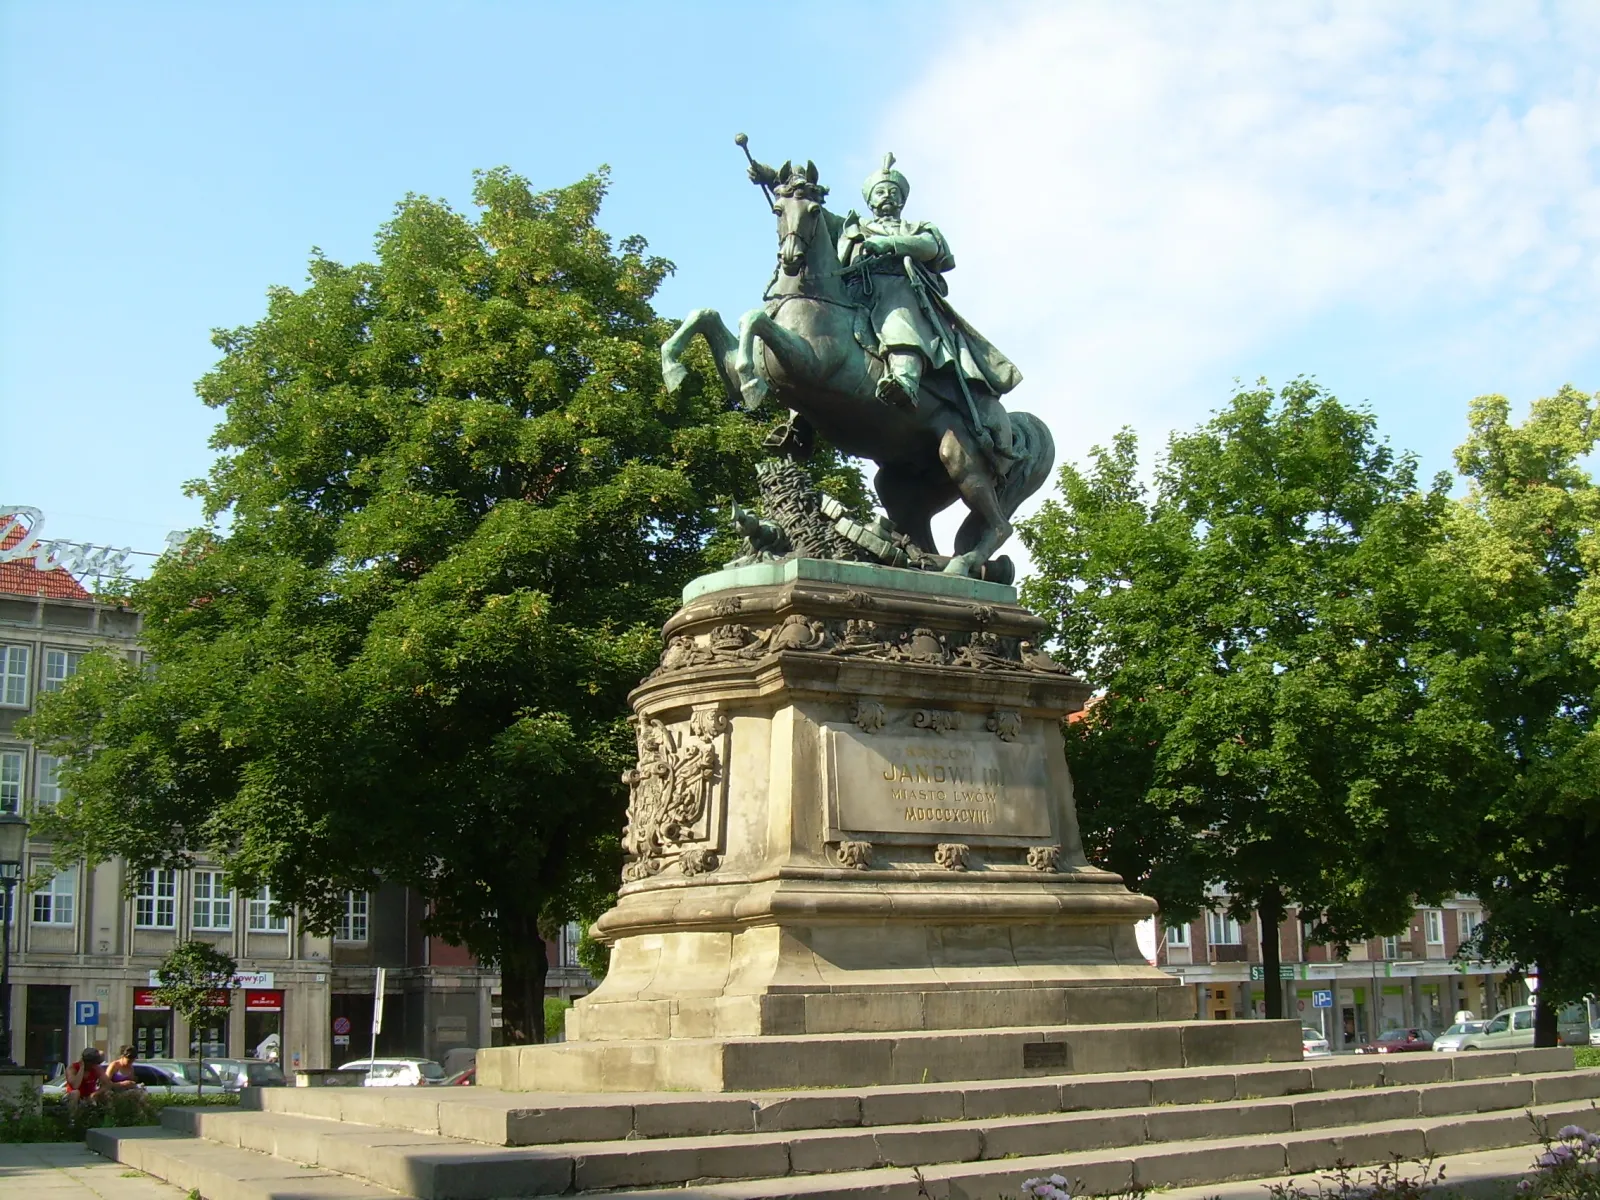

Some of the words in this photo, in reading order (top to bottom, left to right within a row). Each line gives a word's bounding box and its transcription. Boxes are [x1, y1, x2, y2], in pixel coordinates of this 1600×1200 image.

[883, 763, 974, 785] JANOWI
[892, 788, 947, 801] MIASTO
[953, 788, 997, 803] LWÓW
[904, 805, 993, 825] MDCCCXCVIII.
[81, 1003, 95, 1023] P
